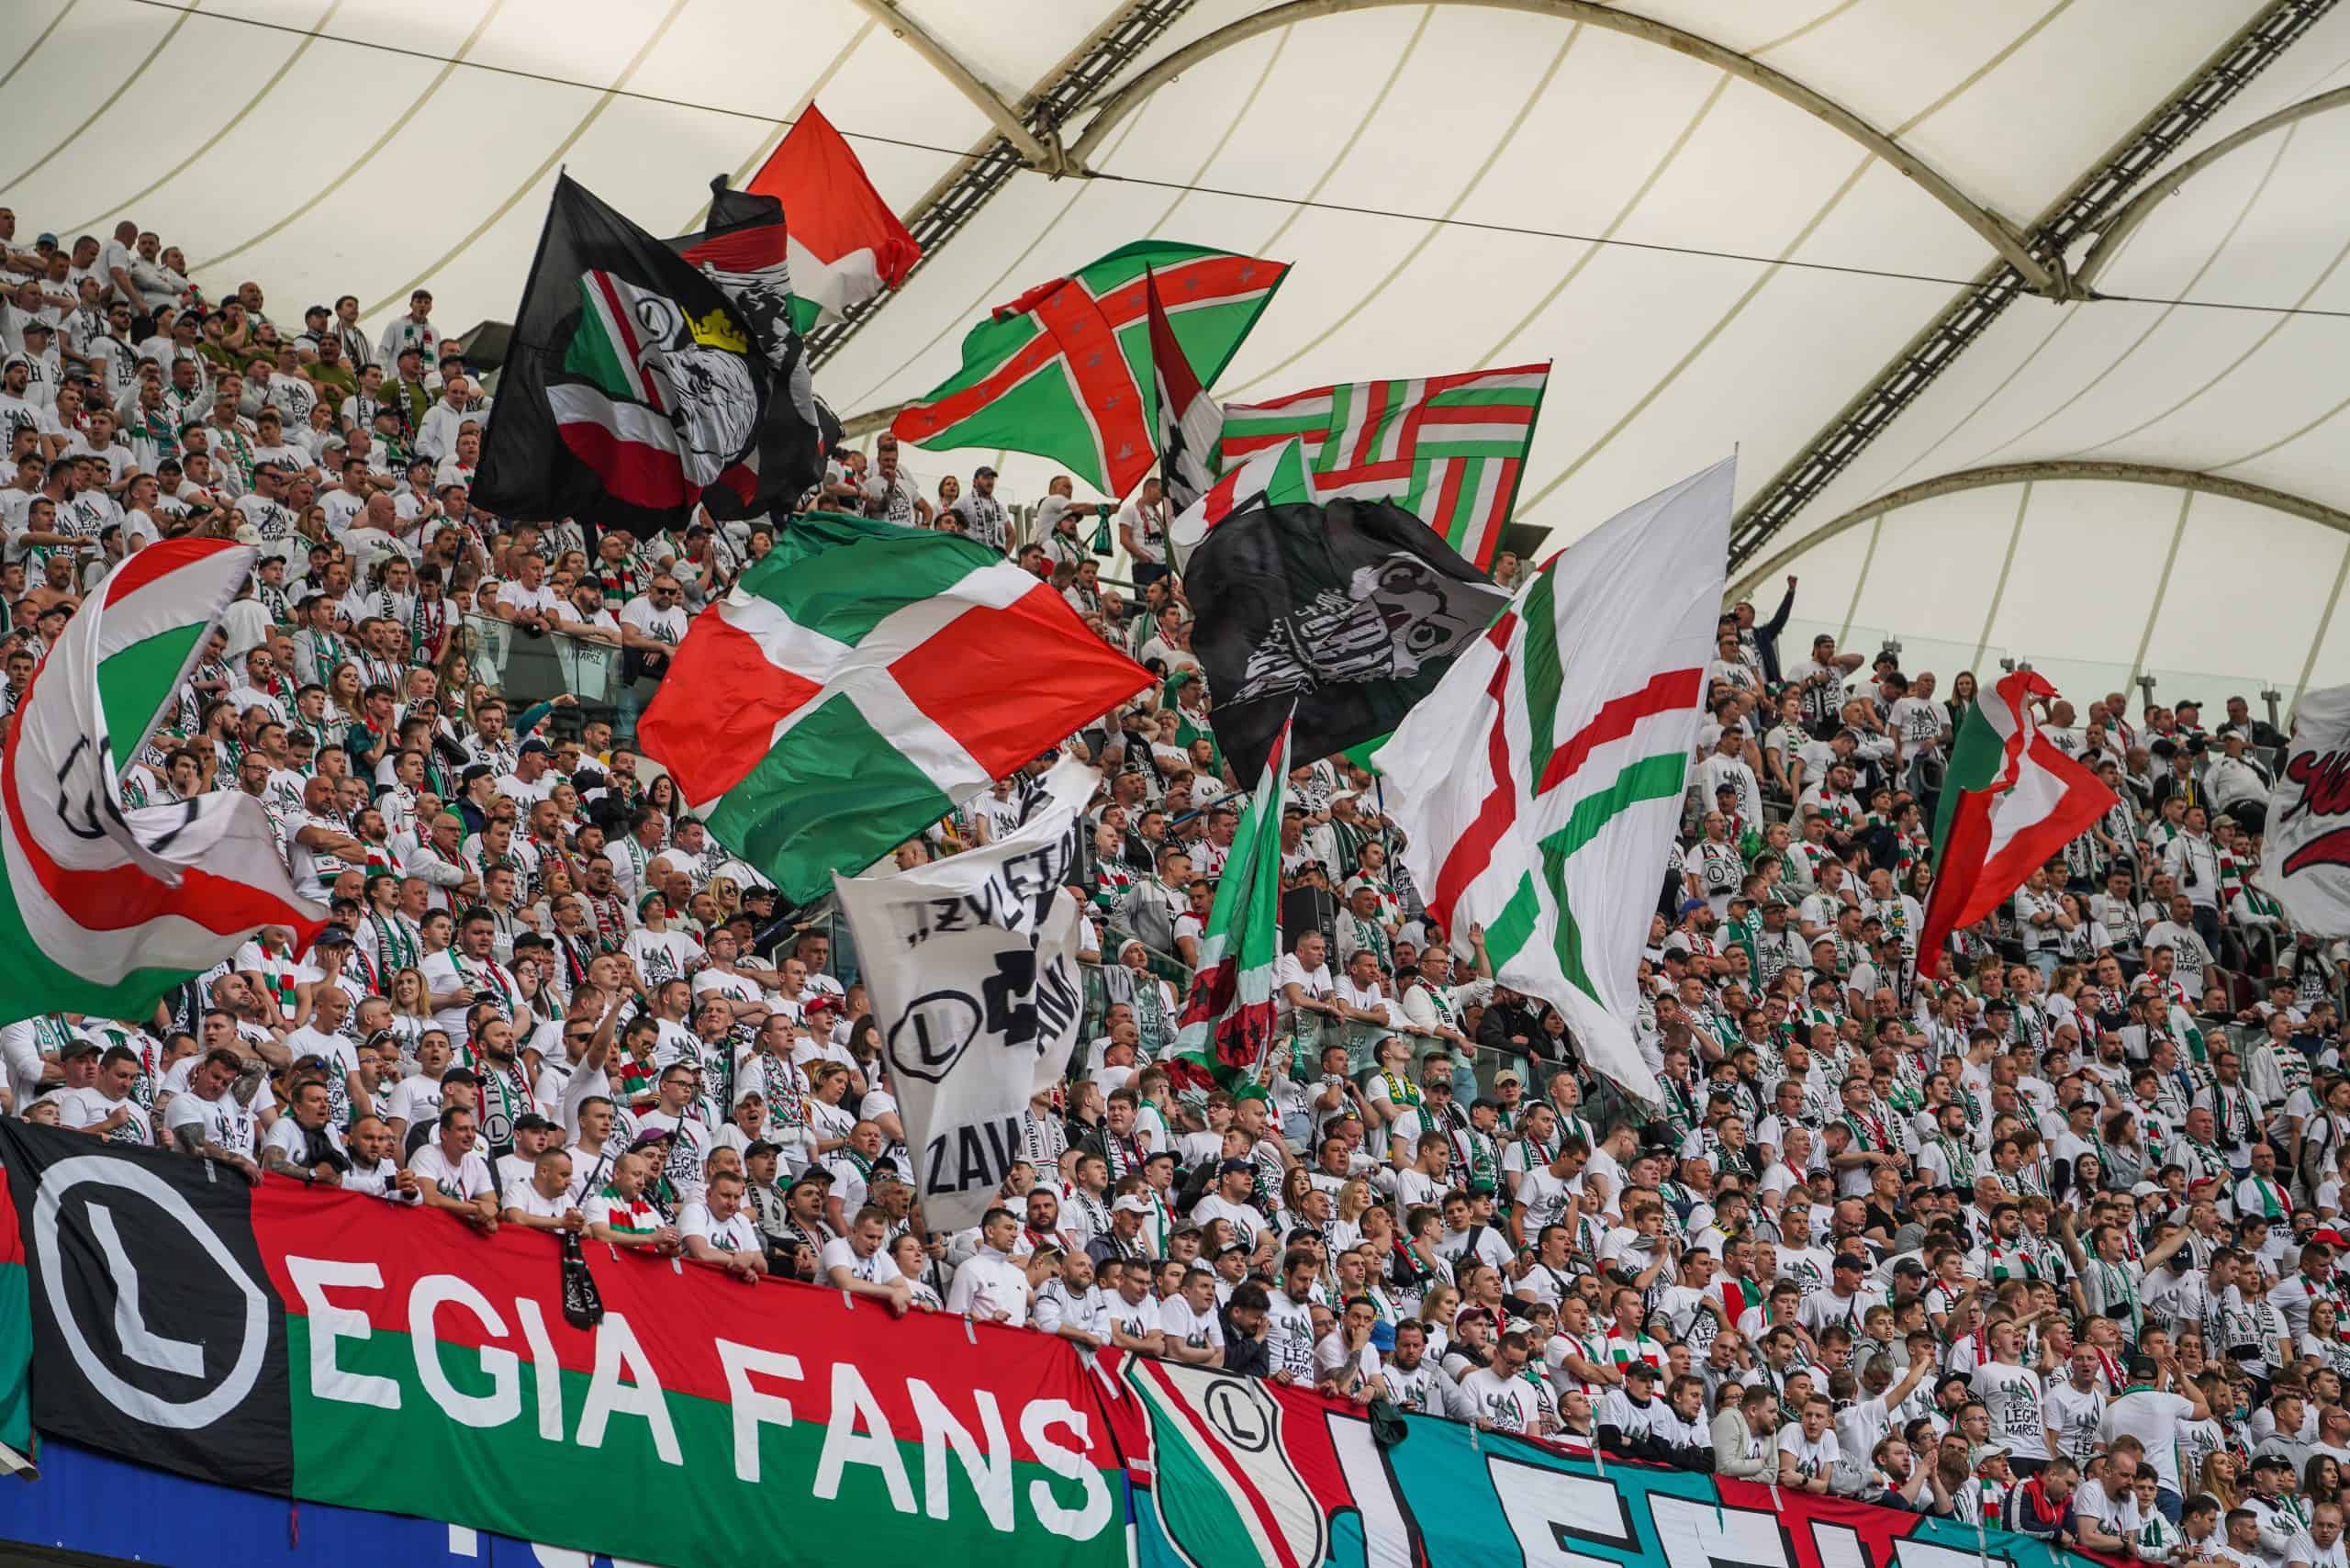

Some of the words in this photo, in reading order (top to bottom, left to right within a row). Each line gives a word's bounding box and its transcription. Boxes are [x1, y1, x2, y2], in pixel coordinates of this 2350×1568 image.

[715, 1336, 1113, 1541] FANS
[1220, 1392, 1258, 1441] L
[2005, 1409, 2041, 1425] LEGIO
